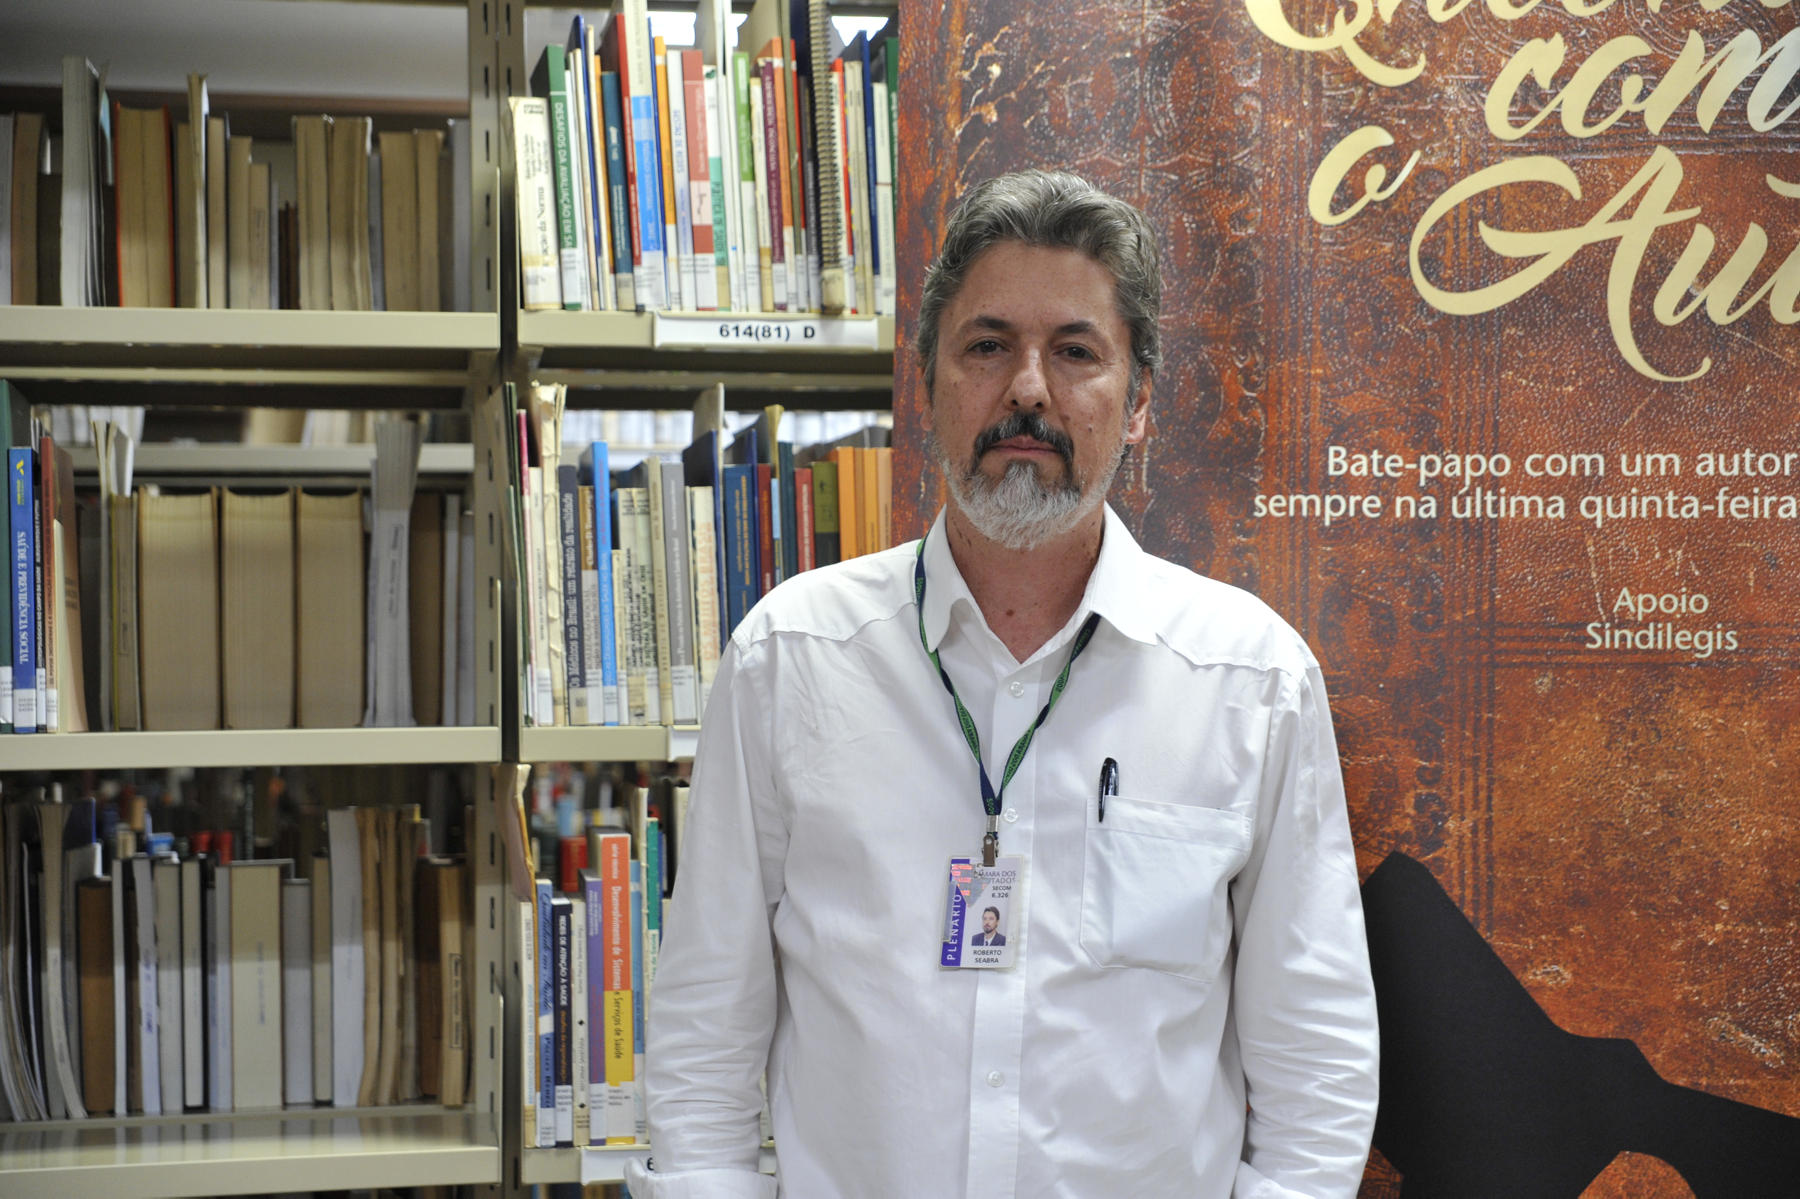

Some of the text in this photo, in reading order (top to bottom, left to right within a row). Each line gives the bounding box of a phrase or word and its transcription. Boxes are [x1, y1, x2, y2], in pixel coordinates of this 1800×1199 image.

[1485, 29, 1800, 141] com
[554, 102, 566, 147] DESAFIOS
[558, 149, 567, 162] DA
[557, 164, 572, 217] AVALIAÇÃO
[1308, 125, 1421, 226] o
[562, 218, 571, 233] EM
[719, 323, 816, 341] 614(81) D
[1327, 445, 1797, 486] Bate-papo com um autor
[1254, 487, 1798, 528] sempre na última quinta-feira
[16, 531, 28, 560] SAÚDE
[17, 570, 30, 629] PREVIDÊNCIA
[563, 493, 579, 687] Os Médicos no Brasil: um retrato da realidade
[1613, 587, 1709, 620] Apoio
[18, 631, 28, 664] SOCIAL
[1586, 622, 1738, 657] Sindilegis
[558, 915, 567, 935] REDES
[611, 885, 622, 944] Desenvolvimento
[558, 936, 567, 945] DE
[612, 946, 621, 954] de
[557, 946, 567, 976] ATENÇÃO
[612, 958, 622, 989] Sistemas
[559, 984, 568, 1006] SAÚDE
[612, 997, 623, 1025] Serviços
[614, 1027, 621, 1036] de
[614, 1038, 623, 1059] Saúde
